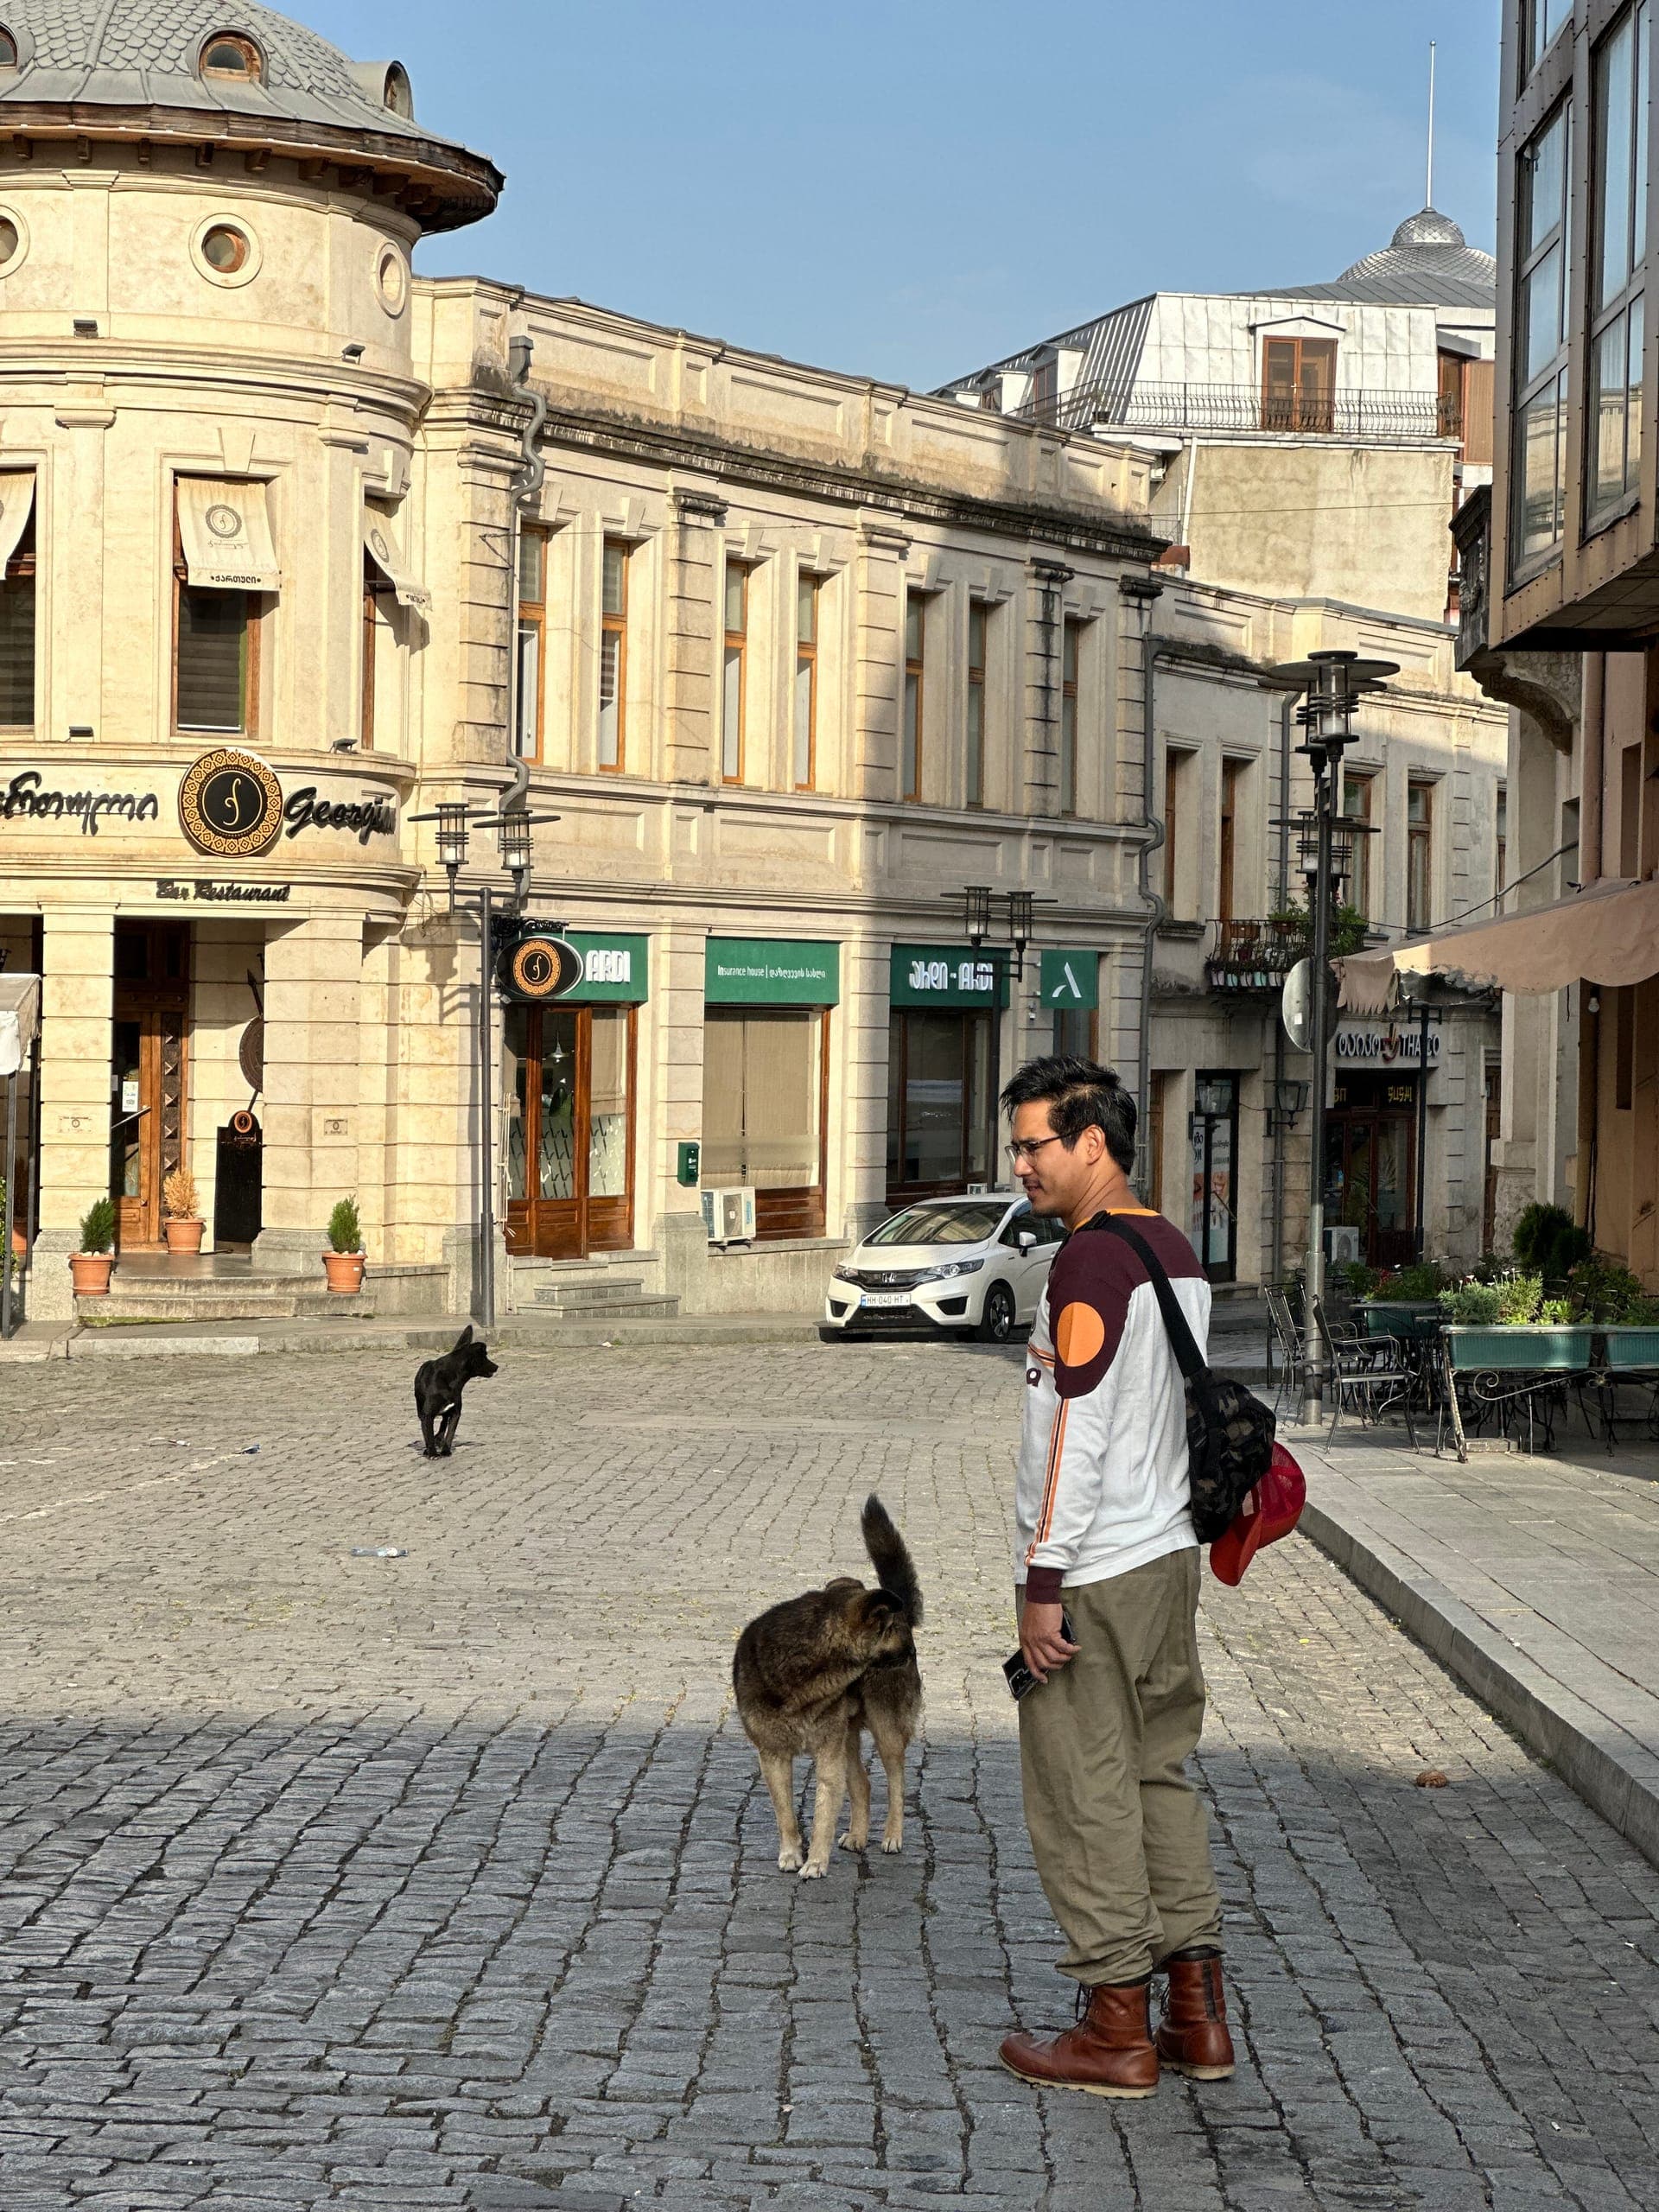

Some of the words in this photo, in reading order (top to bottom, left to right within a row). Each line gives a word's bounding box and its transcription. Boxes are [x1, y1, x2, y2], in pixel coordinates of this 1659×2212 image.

[156, 879, 189, 900] Bar
[194, 879, 290, 901] Restaurant
[586, 950, 631, 982] ARDI
[717, 964, 747, 976] Insurance
[747, 965, 766, 976] house
[1402, 1033, 1440, 1057] THACO
